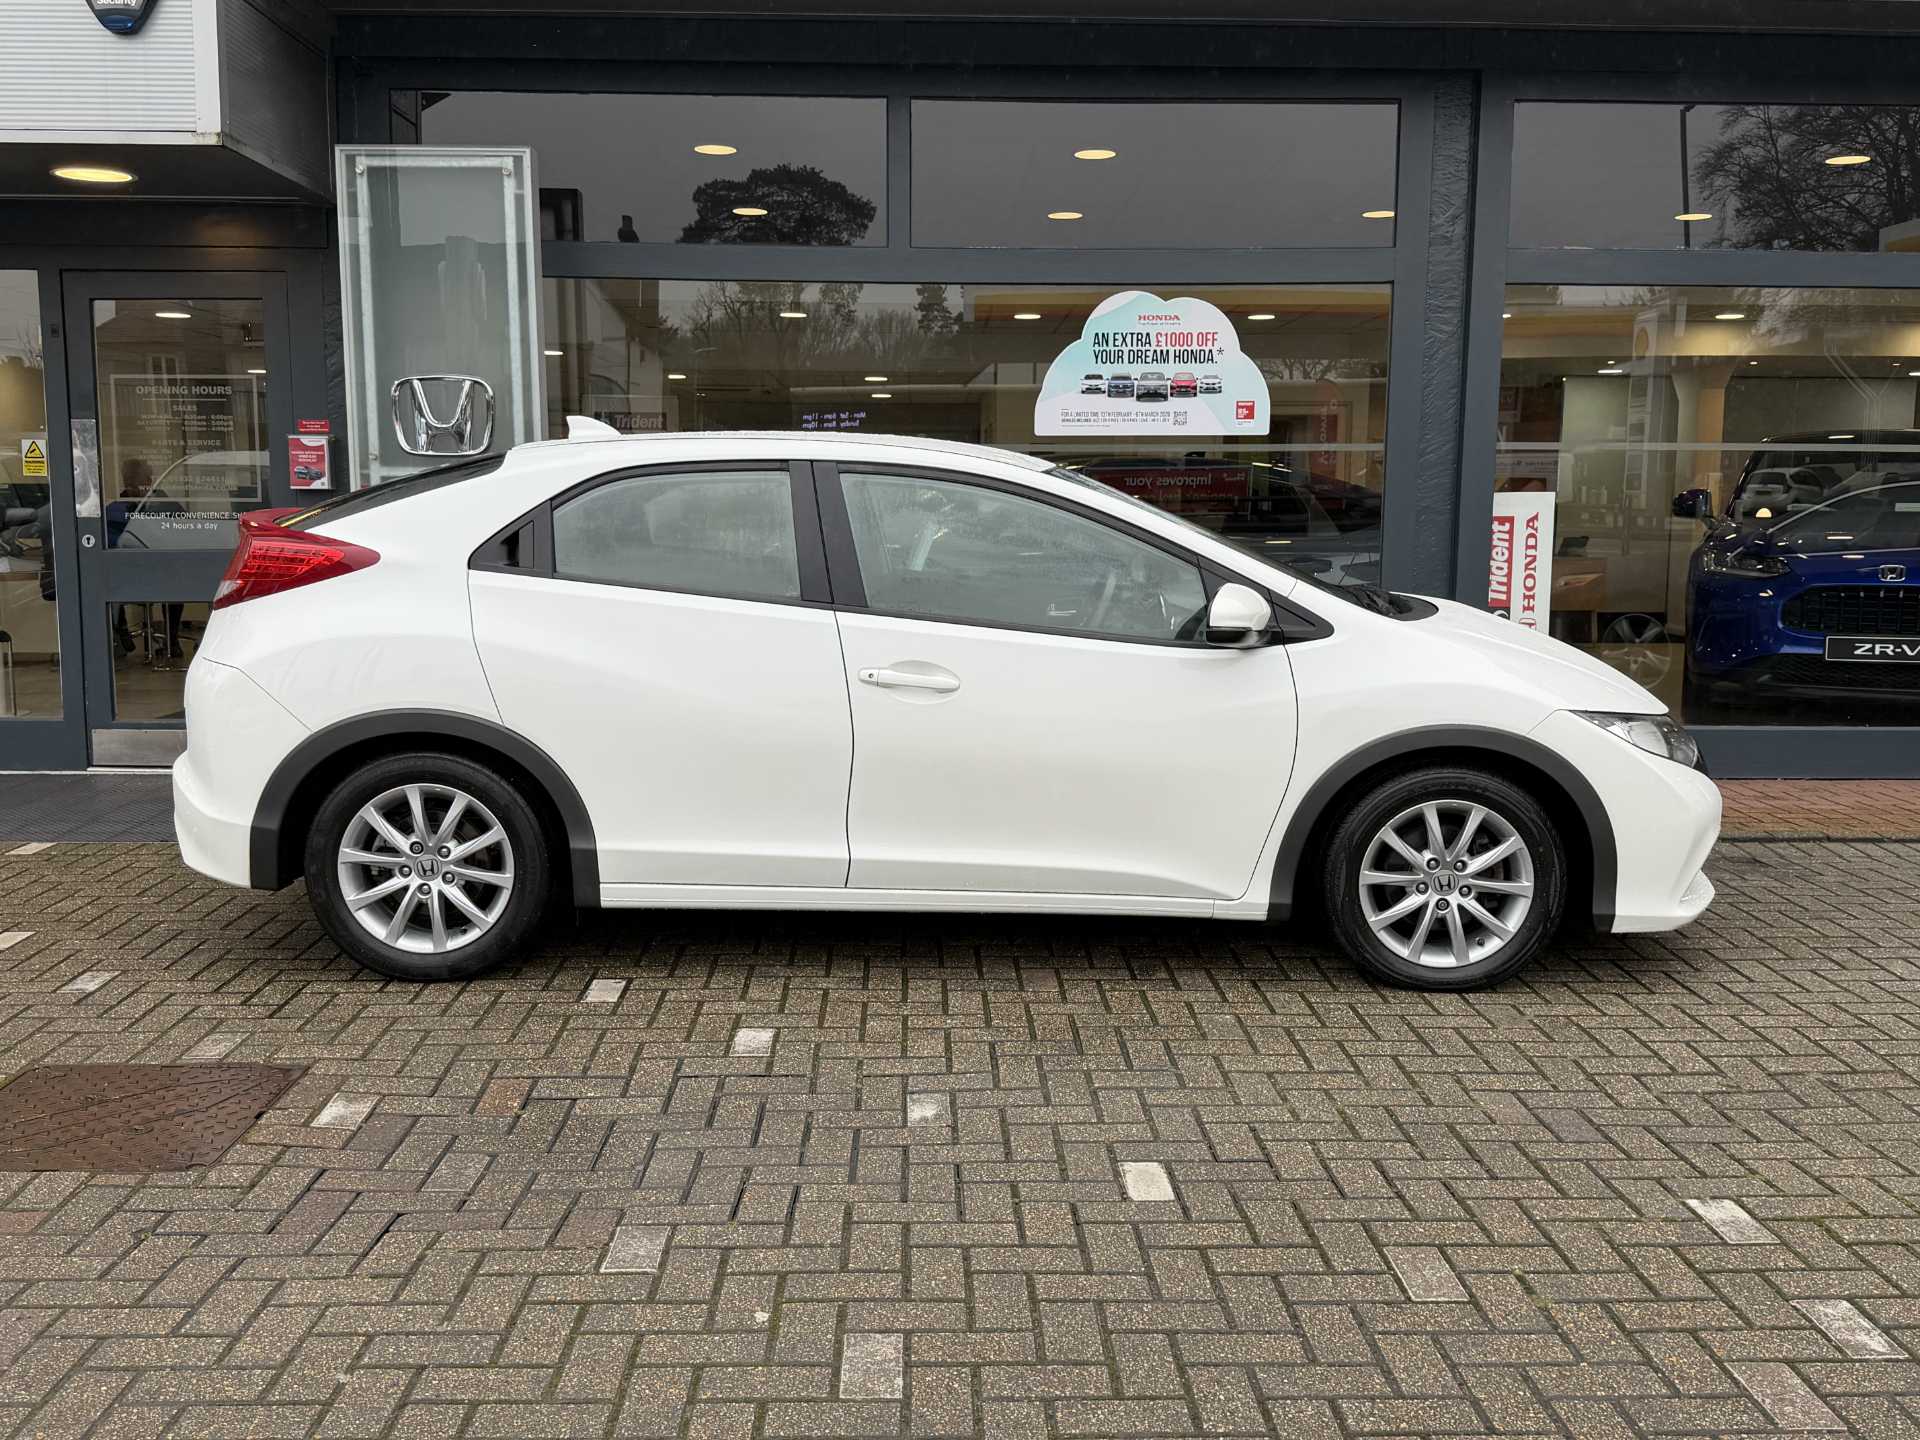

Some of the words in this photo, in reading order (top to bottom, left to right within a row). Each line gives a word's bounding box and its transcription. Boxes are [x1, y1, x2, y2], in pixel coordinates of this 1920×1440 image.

[1093, 332, 1108, 348] AN
[1113, 332, 1152, 348] EXTRA
[1155, 332, 1192, 347] £1000
[1197, 332, 1218, 347] OFF
[1093, 349, 1124, 365] YOUR
[1128, 349, 1170, 364] DREAM
[136, 385, 188, 395] OPENING
[192, 385, 233, 395] HOURS
[615, 415, 664, 428] Trident
[204, 522, 218, 531] day
[1489, 520, 1510, 601] Trident
[1522, 512, 1539, 613] HONDA
[1853, 643, 1920, 656] ZR-V
